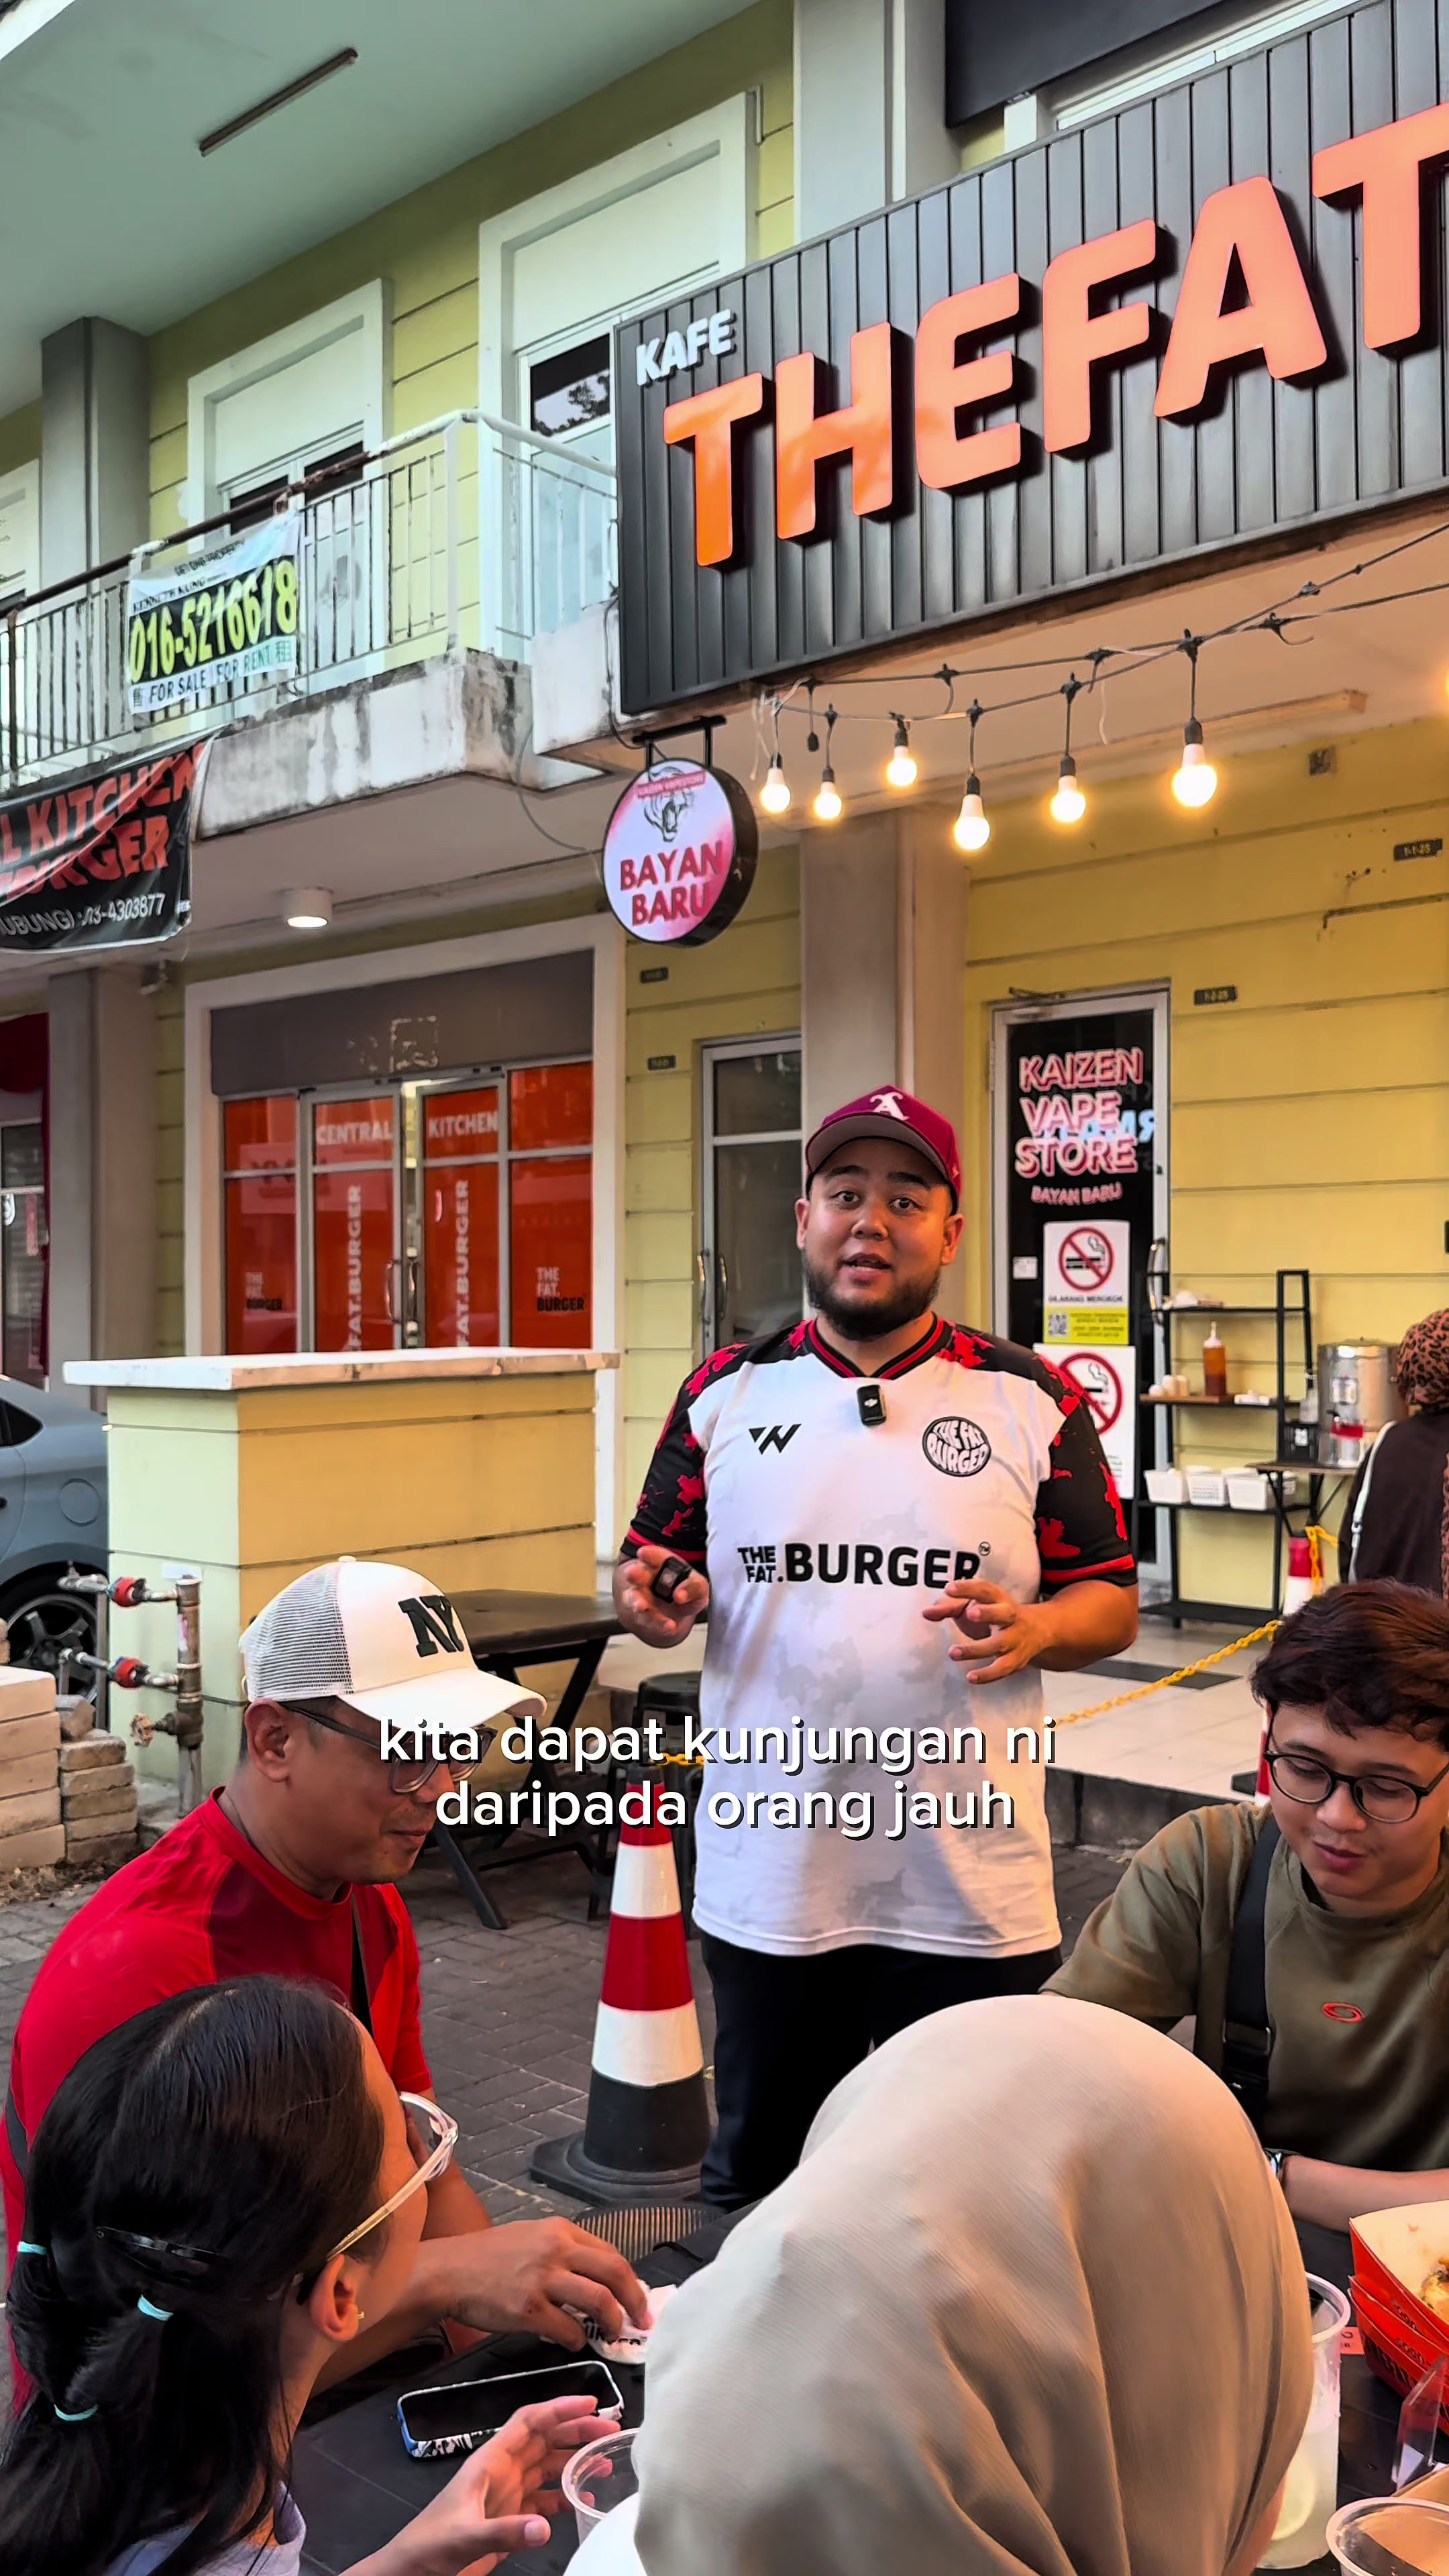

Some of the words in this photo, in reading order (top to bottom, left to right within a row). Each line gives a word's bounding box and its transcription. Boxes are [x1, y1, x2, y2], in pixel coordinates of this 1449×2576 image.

[636, 309, 732, 386] KAFE
[149, 681, 174, 704] FOR
[177, 669, 207, 696] SALE
[620, 841, 723, 891] BAYAN
[0, 908, 74, 935] UBUNGI
[632, 882, 712, 926] BARU
[1019, 1046, 1144, 1093] KAIZEN
[428, 1111, 498, 1139] KITCHEN
[1019, 1090, 1122, 1136] VAPE
[316, 1120, 393, 1145] CENTRAL
[1014, 1134, 1138, 1179] STORE
[1031, 1185, 1081, 1205] BAYAN
[1081, 1181, 1124, 1205] BARU
[537, 1267, 559, 1281] THE
[537, 1297, 584, 1311] BURGER
[926, 1432, 989, 1474] BURGER
[932, 1420, 963, 1450] THE
[960, 1421, 986, 1450] FAT
[737, 1546, 776, 1564] THE
[785, 1542, 981, 1589] BURGER
[398, 1595, 465, 1658] NY
